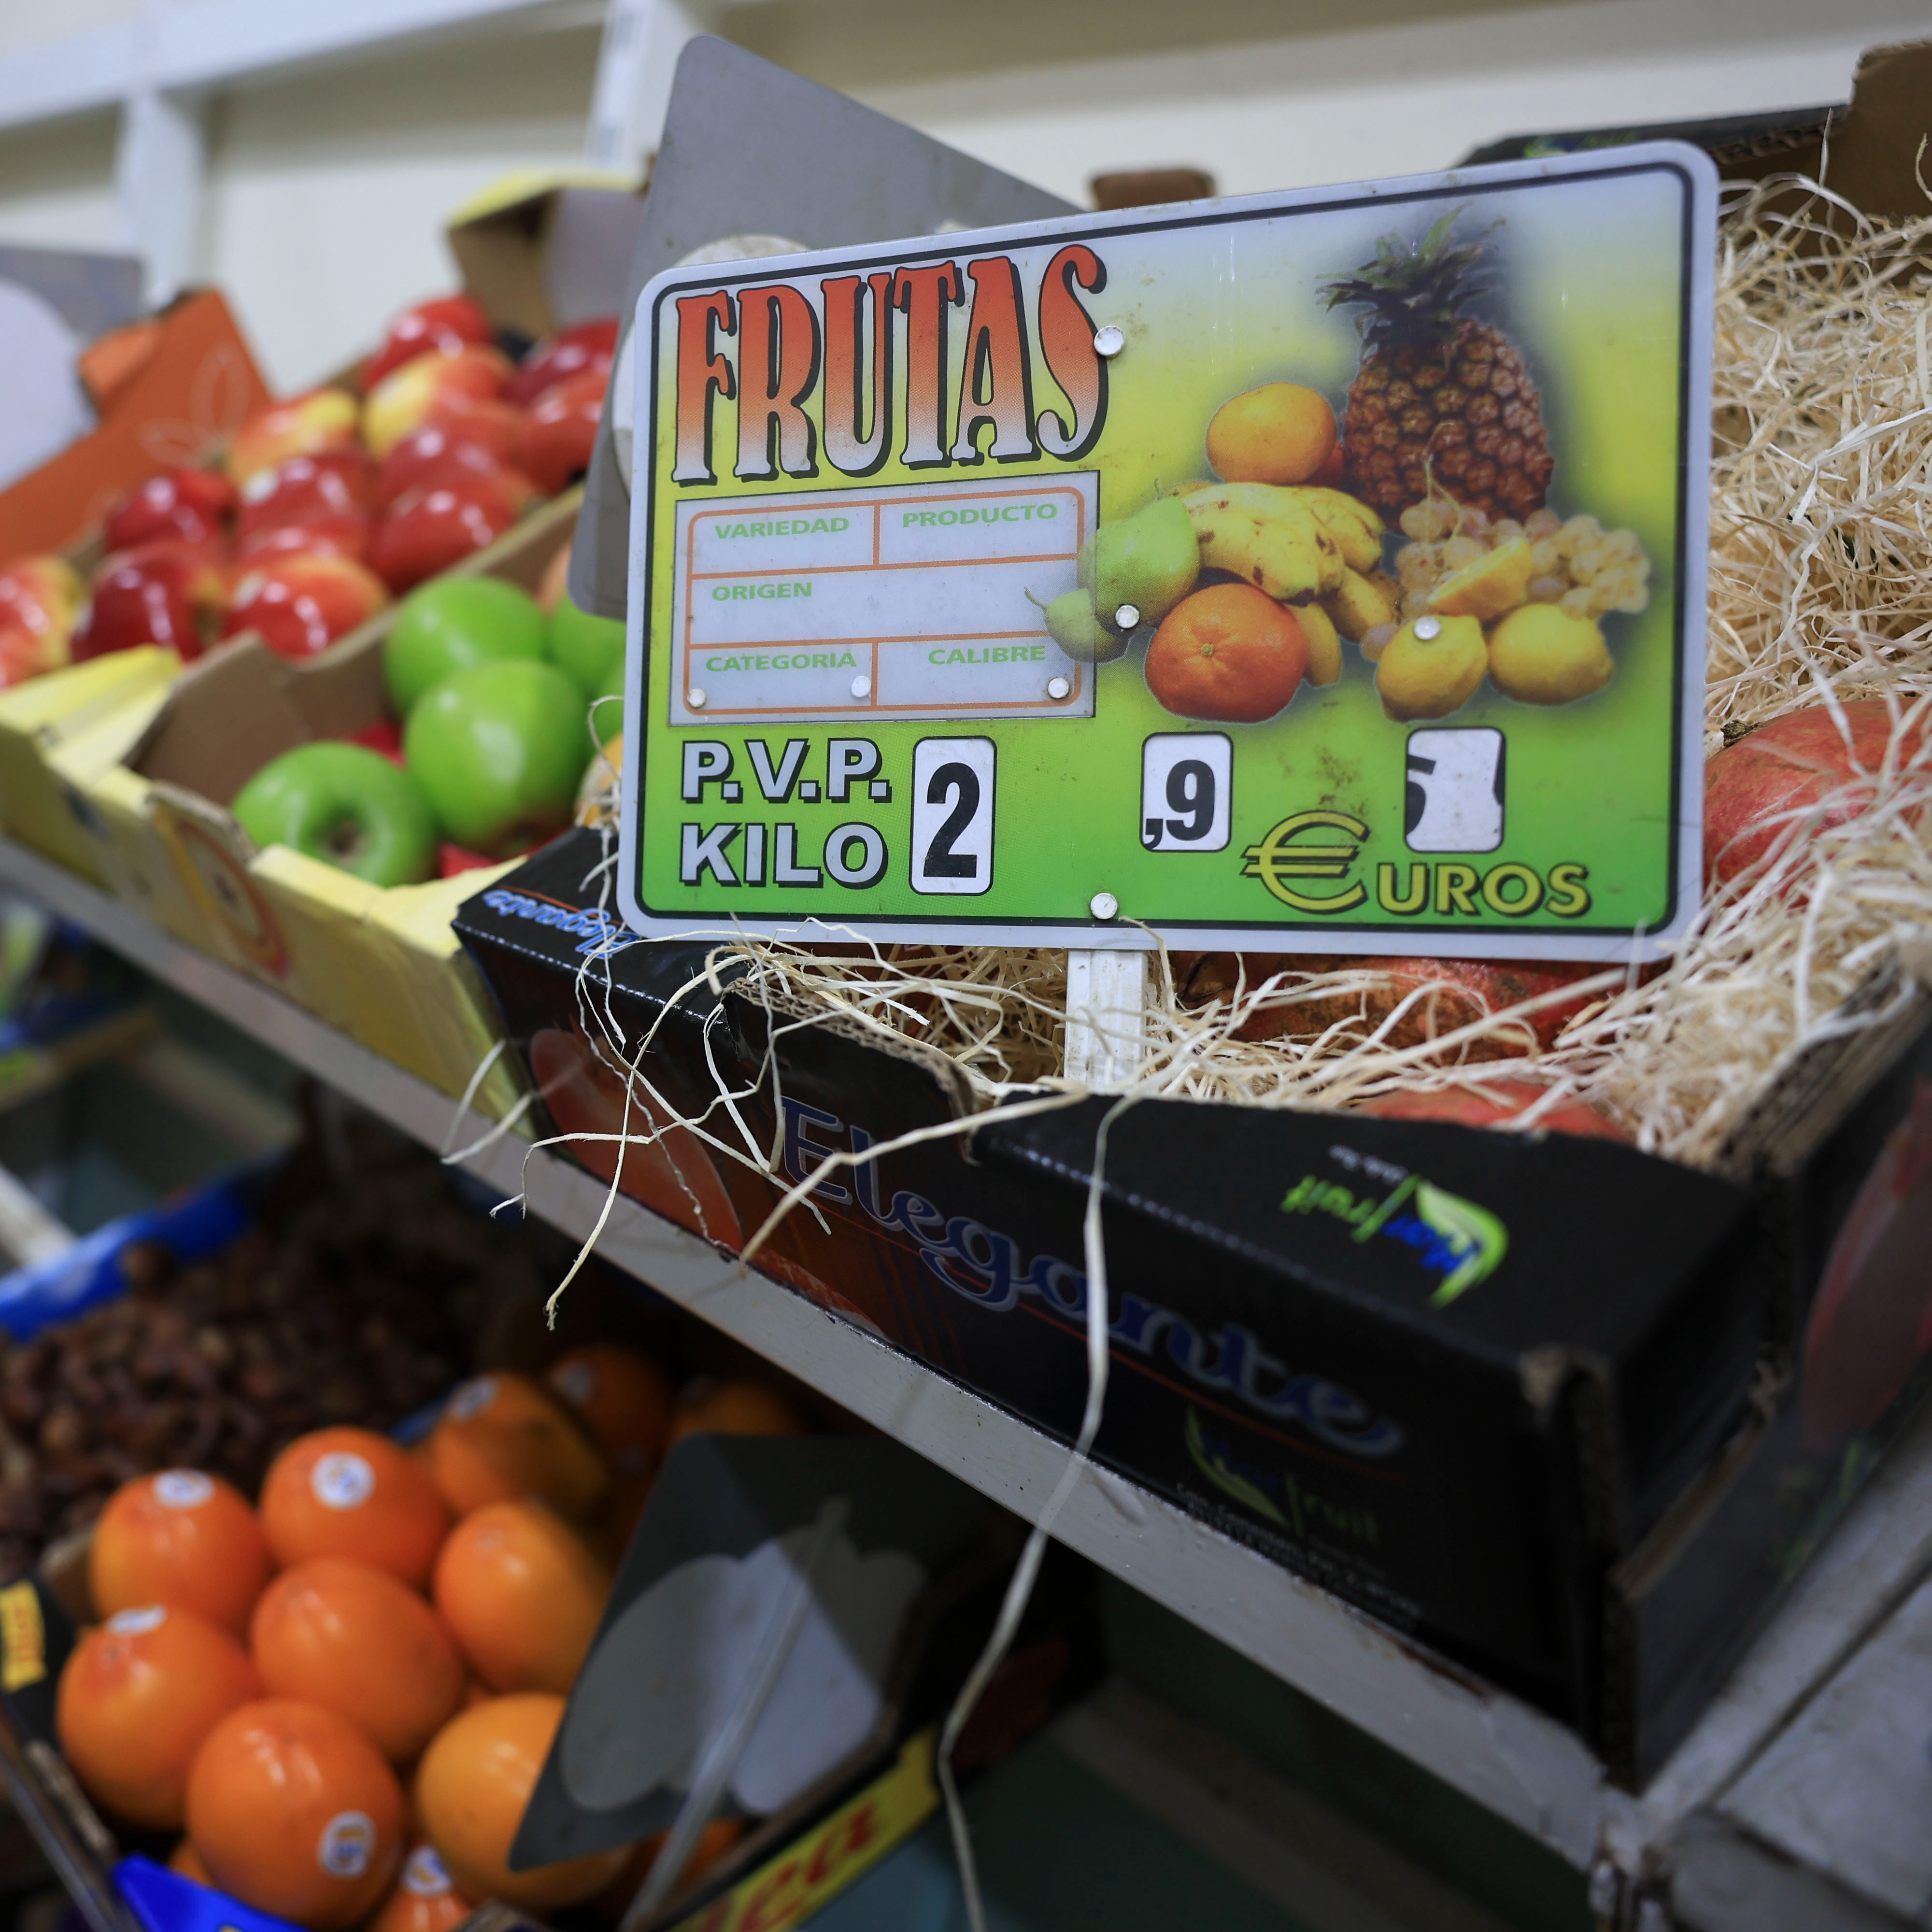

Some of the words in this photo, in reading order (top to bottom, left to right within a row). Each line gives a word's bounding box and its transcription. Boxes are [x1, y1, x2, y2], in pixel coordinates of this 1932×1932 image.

[671, 244, 1110, 487] FRUTAS
[714, 517, 850, 540] VARIEDAD
[903, 503, 1058, 528] PRODUCTO
[711, 582, 812, 602] ORIGEN
[706, 652, 857, 672] CATEGORIA
[927, 645, 1046, 665] CALIBRE
[682, 738, 893, 803] P.V.P.
[923, 762, 980, 878] 2
[679, 822, 889, 889] KILO
[482, 889, 642, 960] Elegante
[781, 1094, 1403, 1457] Elegante
